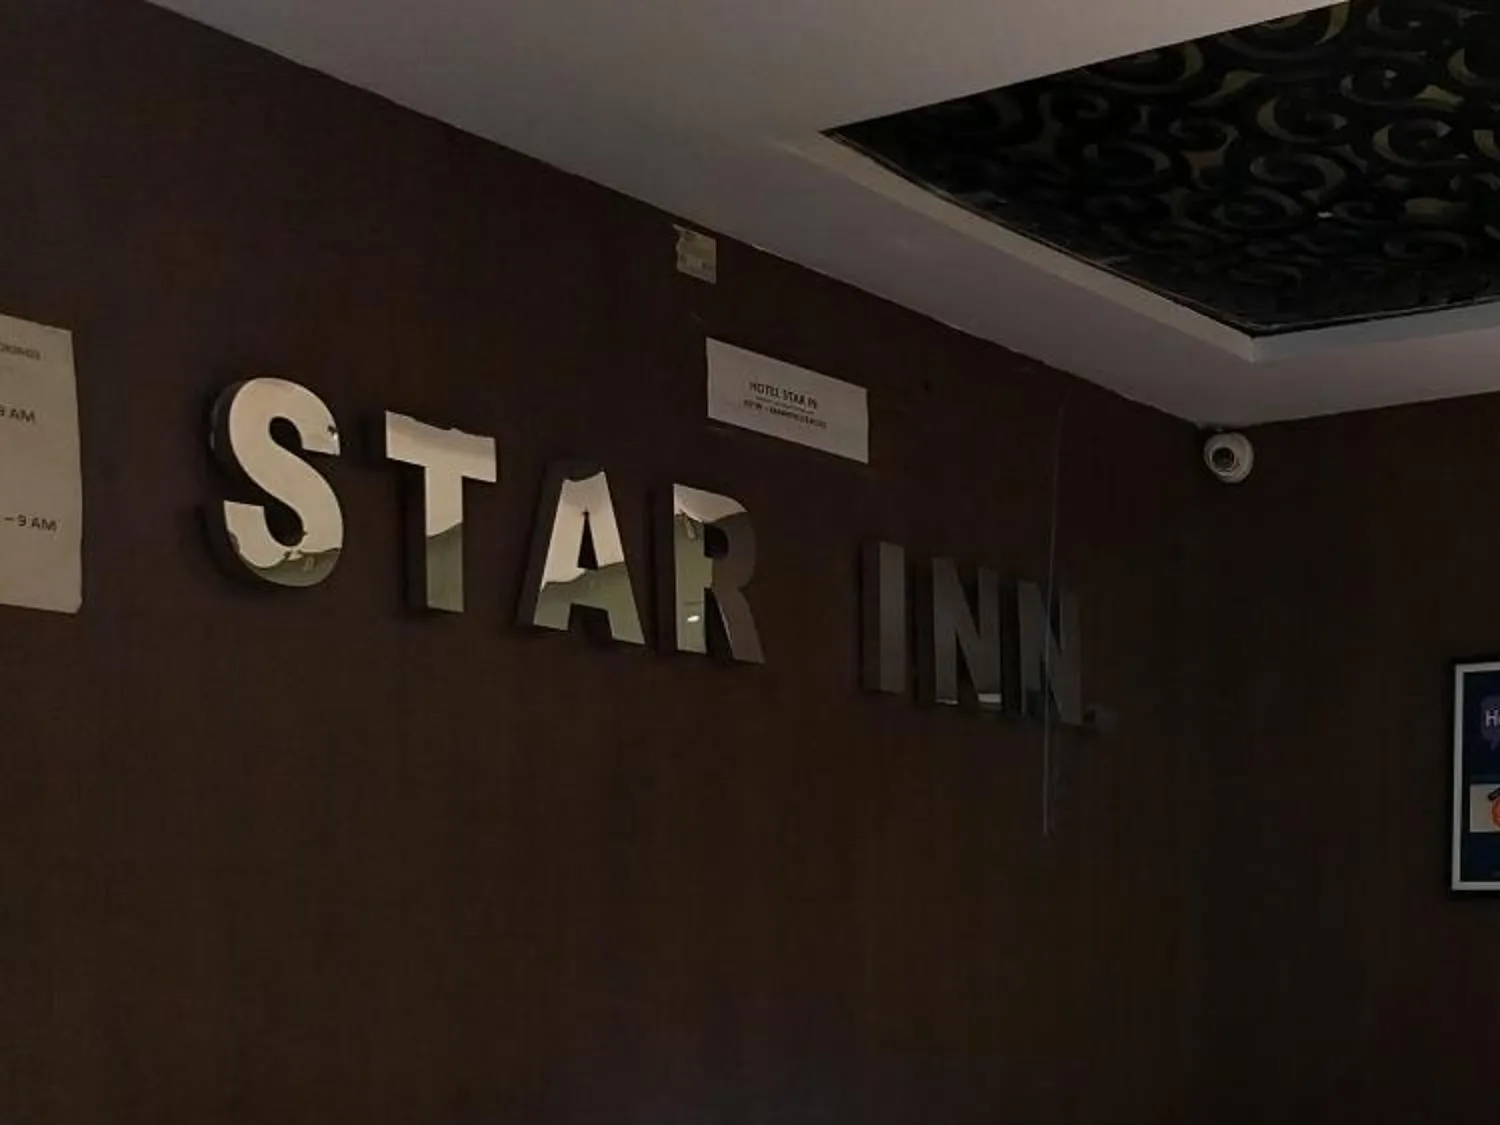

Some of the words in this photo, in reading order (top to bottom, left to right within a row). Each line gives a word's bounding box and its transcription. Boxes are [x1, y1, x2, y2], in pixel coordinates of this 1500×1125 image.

[10, 408, 35, 423] AM
[31, 517, 57, 533] AM
[222, 376, 766, 664] STAR
[877, 540, 1083, 727] INN
